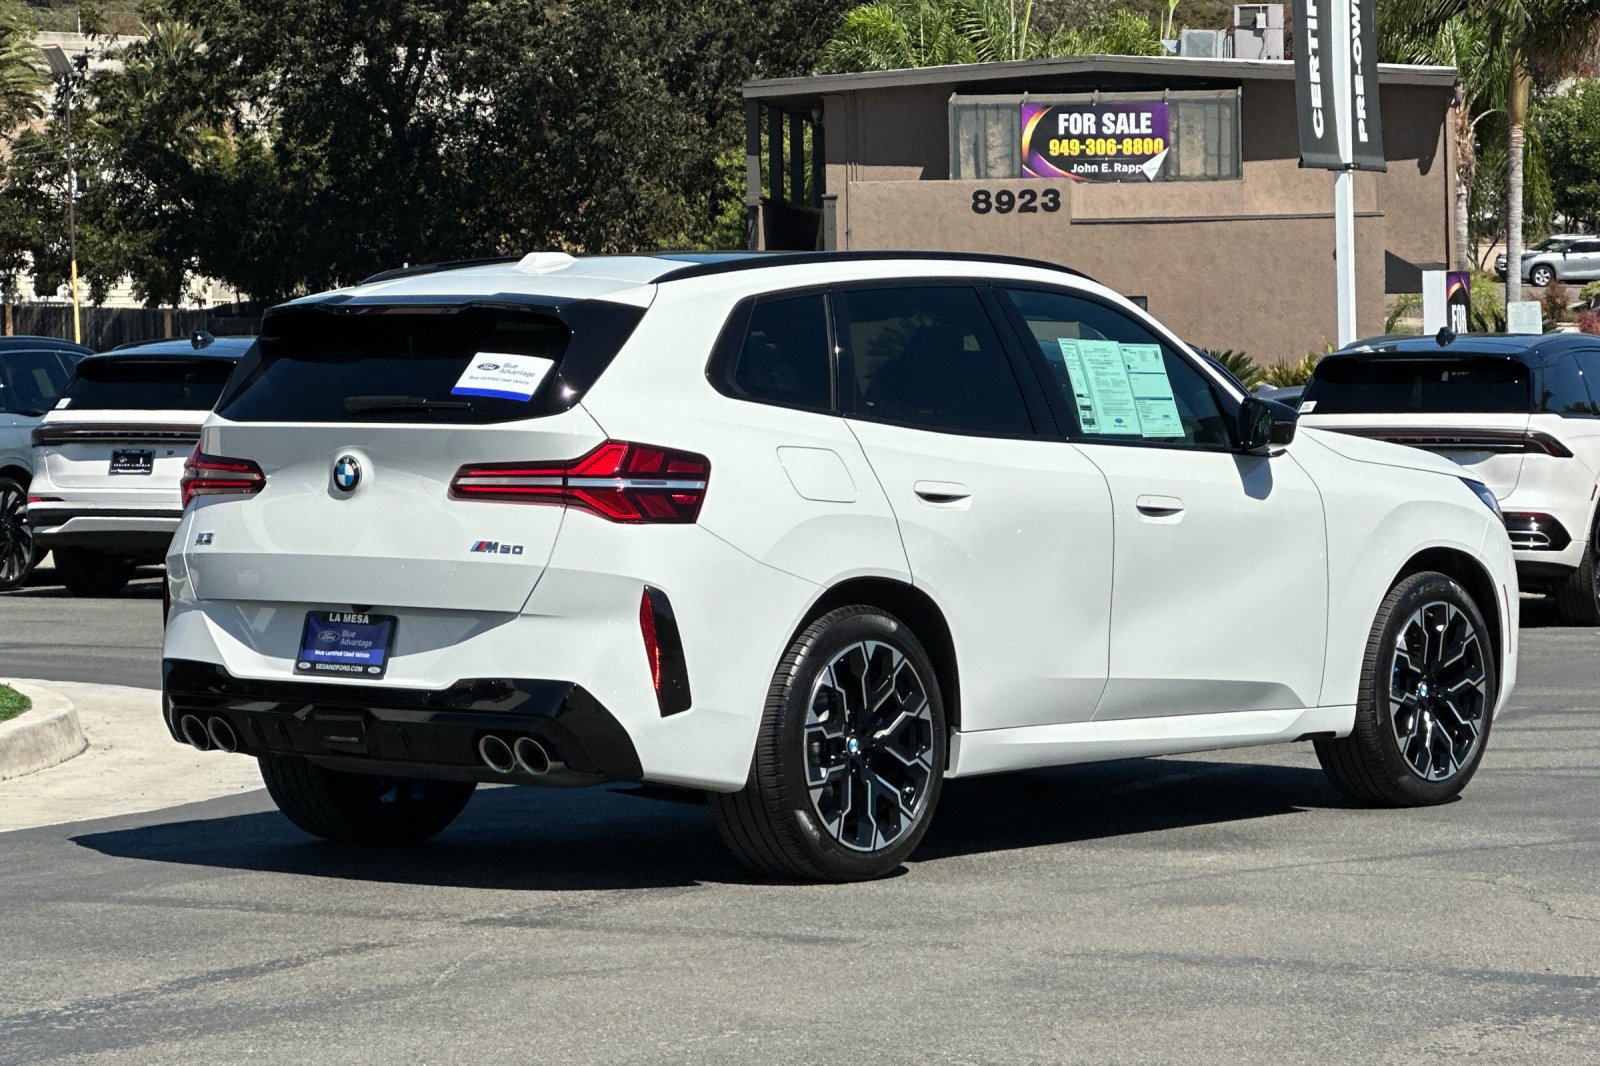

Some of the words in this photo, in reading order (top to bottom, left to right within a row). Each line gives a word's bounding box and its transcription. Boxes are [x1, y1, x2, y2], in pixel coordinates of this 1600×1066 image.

[1351, 0, 1369, 142] PRE-OW
[1058, 113, 1097, 135] FOR
[1102, 112, 1153, 134] SALE
[1049, 138, 1164, 156] 949-306-8800
[1070, 162, 1099, 174] John
[1101, 162, 1112, 173] E.
[971, 188, 1061, 214] 8923
[1451, 304, 1468, 334] FOR
[499, 368, 535, 378] Advantage
[329, 612, 341, 622] LA
[343, 613, 369, 624] MESA
[342, 630, 356, 638] Blue
[340, 639, 372, 648] Advantage
